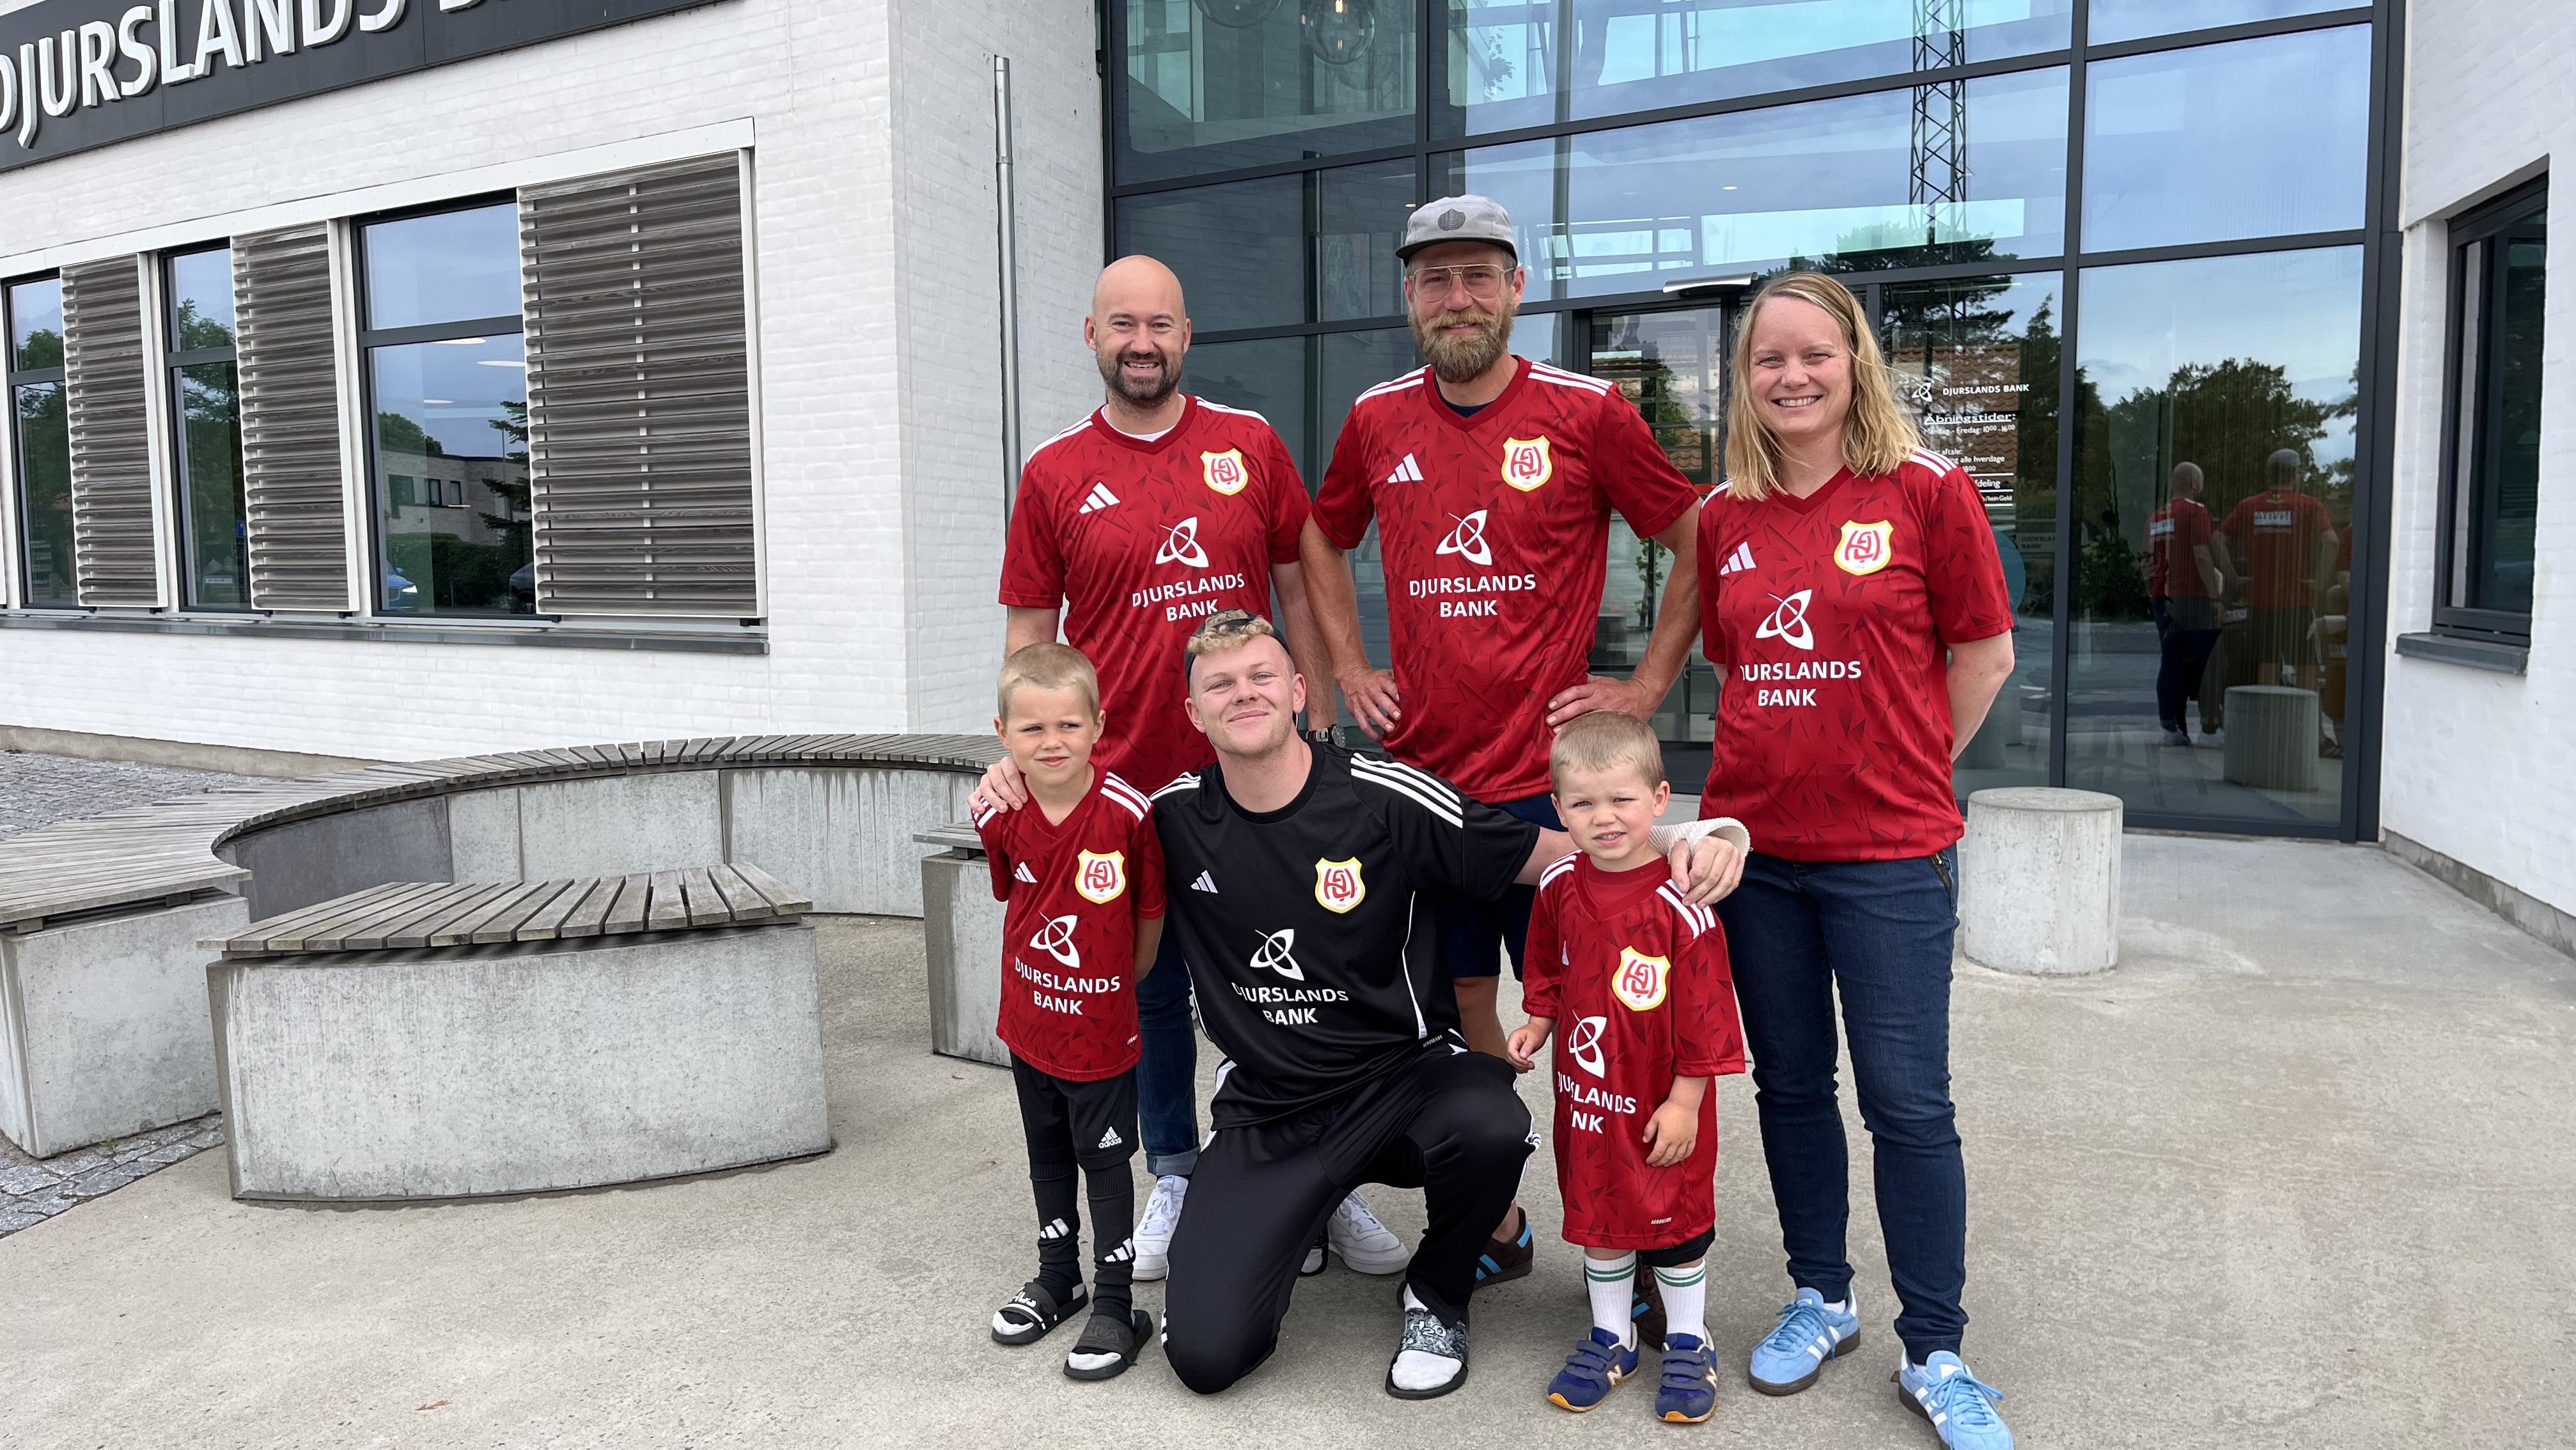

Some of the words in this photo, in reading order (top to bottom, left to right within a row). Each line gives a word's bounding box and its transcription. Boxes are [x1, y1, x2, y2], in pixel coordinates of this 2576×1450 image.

[1942, 385, 2001, 396] DJURSLANDS
[2003, 384, 2029, 392] BANK
[1924, 412, 2016, 425] Åbningstider:
[1973, 455, 2005, 464] hverdage
[1132, 573, 1245, 607] DJURSLANDS
[1409, 574, 1536, 598] DJURSLANDS
[1166, 599, 1219, 621] BANK
[1440, 600, 1498, 618] BANK
[1758, 689, 1817, 706] BANK
[1015, 956, 1120, 994] DJURSLANDS
[1033, 990, 1083, 1015] BANK
[1263, 1008, 1318, 1025] BANK
[1098, 1137, 1122, 1148] adidas
